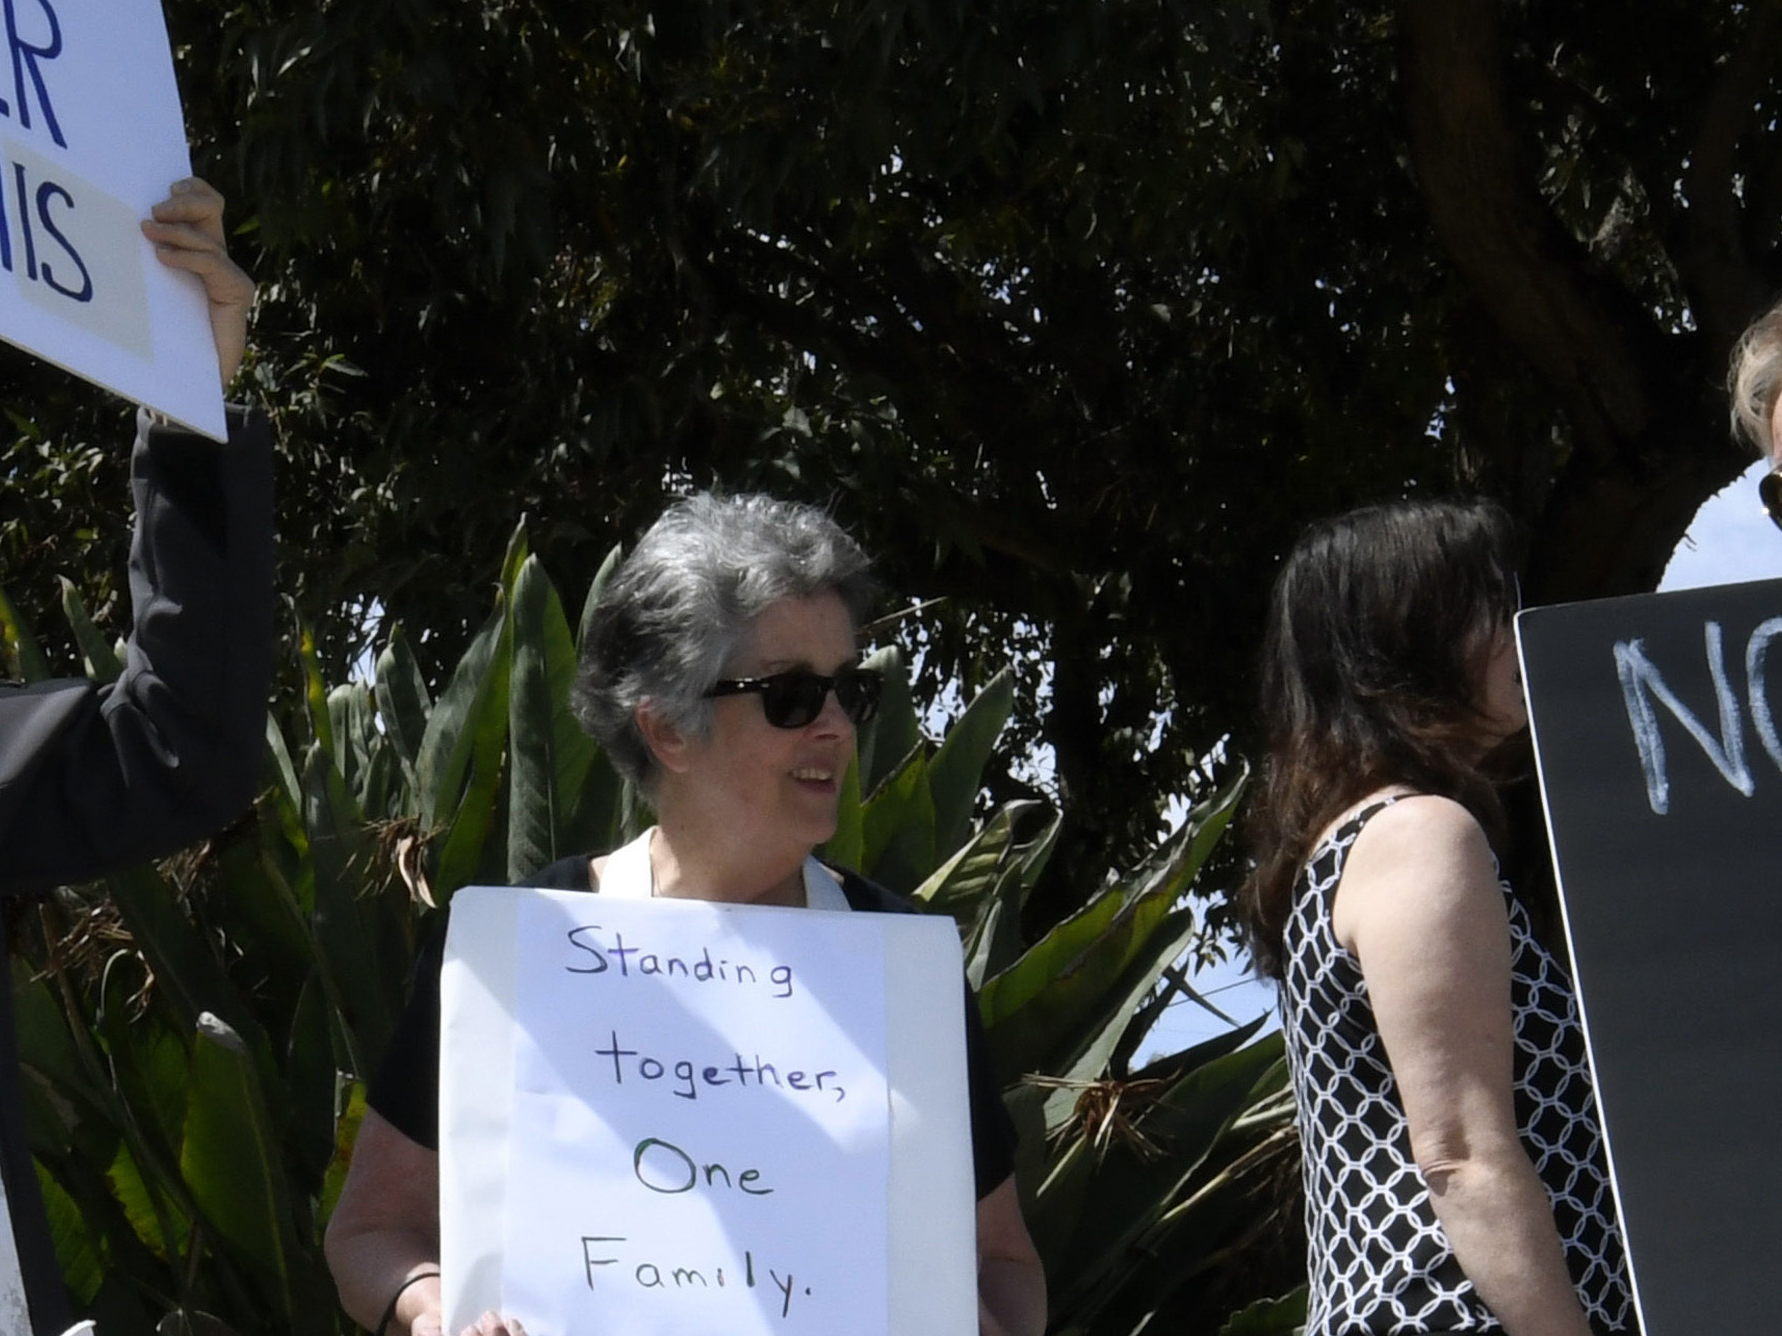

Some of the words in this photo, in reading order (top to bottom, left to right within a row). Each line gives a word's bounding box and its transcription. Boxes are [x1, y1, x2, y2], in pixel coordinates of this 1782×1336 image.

[565, 925, 794, 998] Standing
[595, 1030, 846, 1102] together,
[634, 1138, 775, 1195] One
[579, 1236, 813, 1317] Family.
